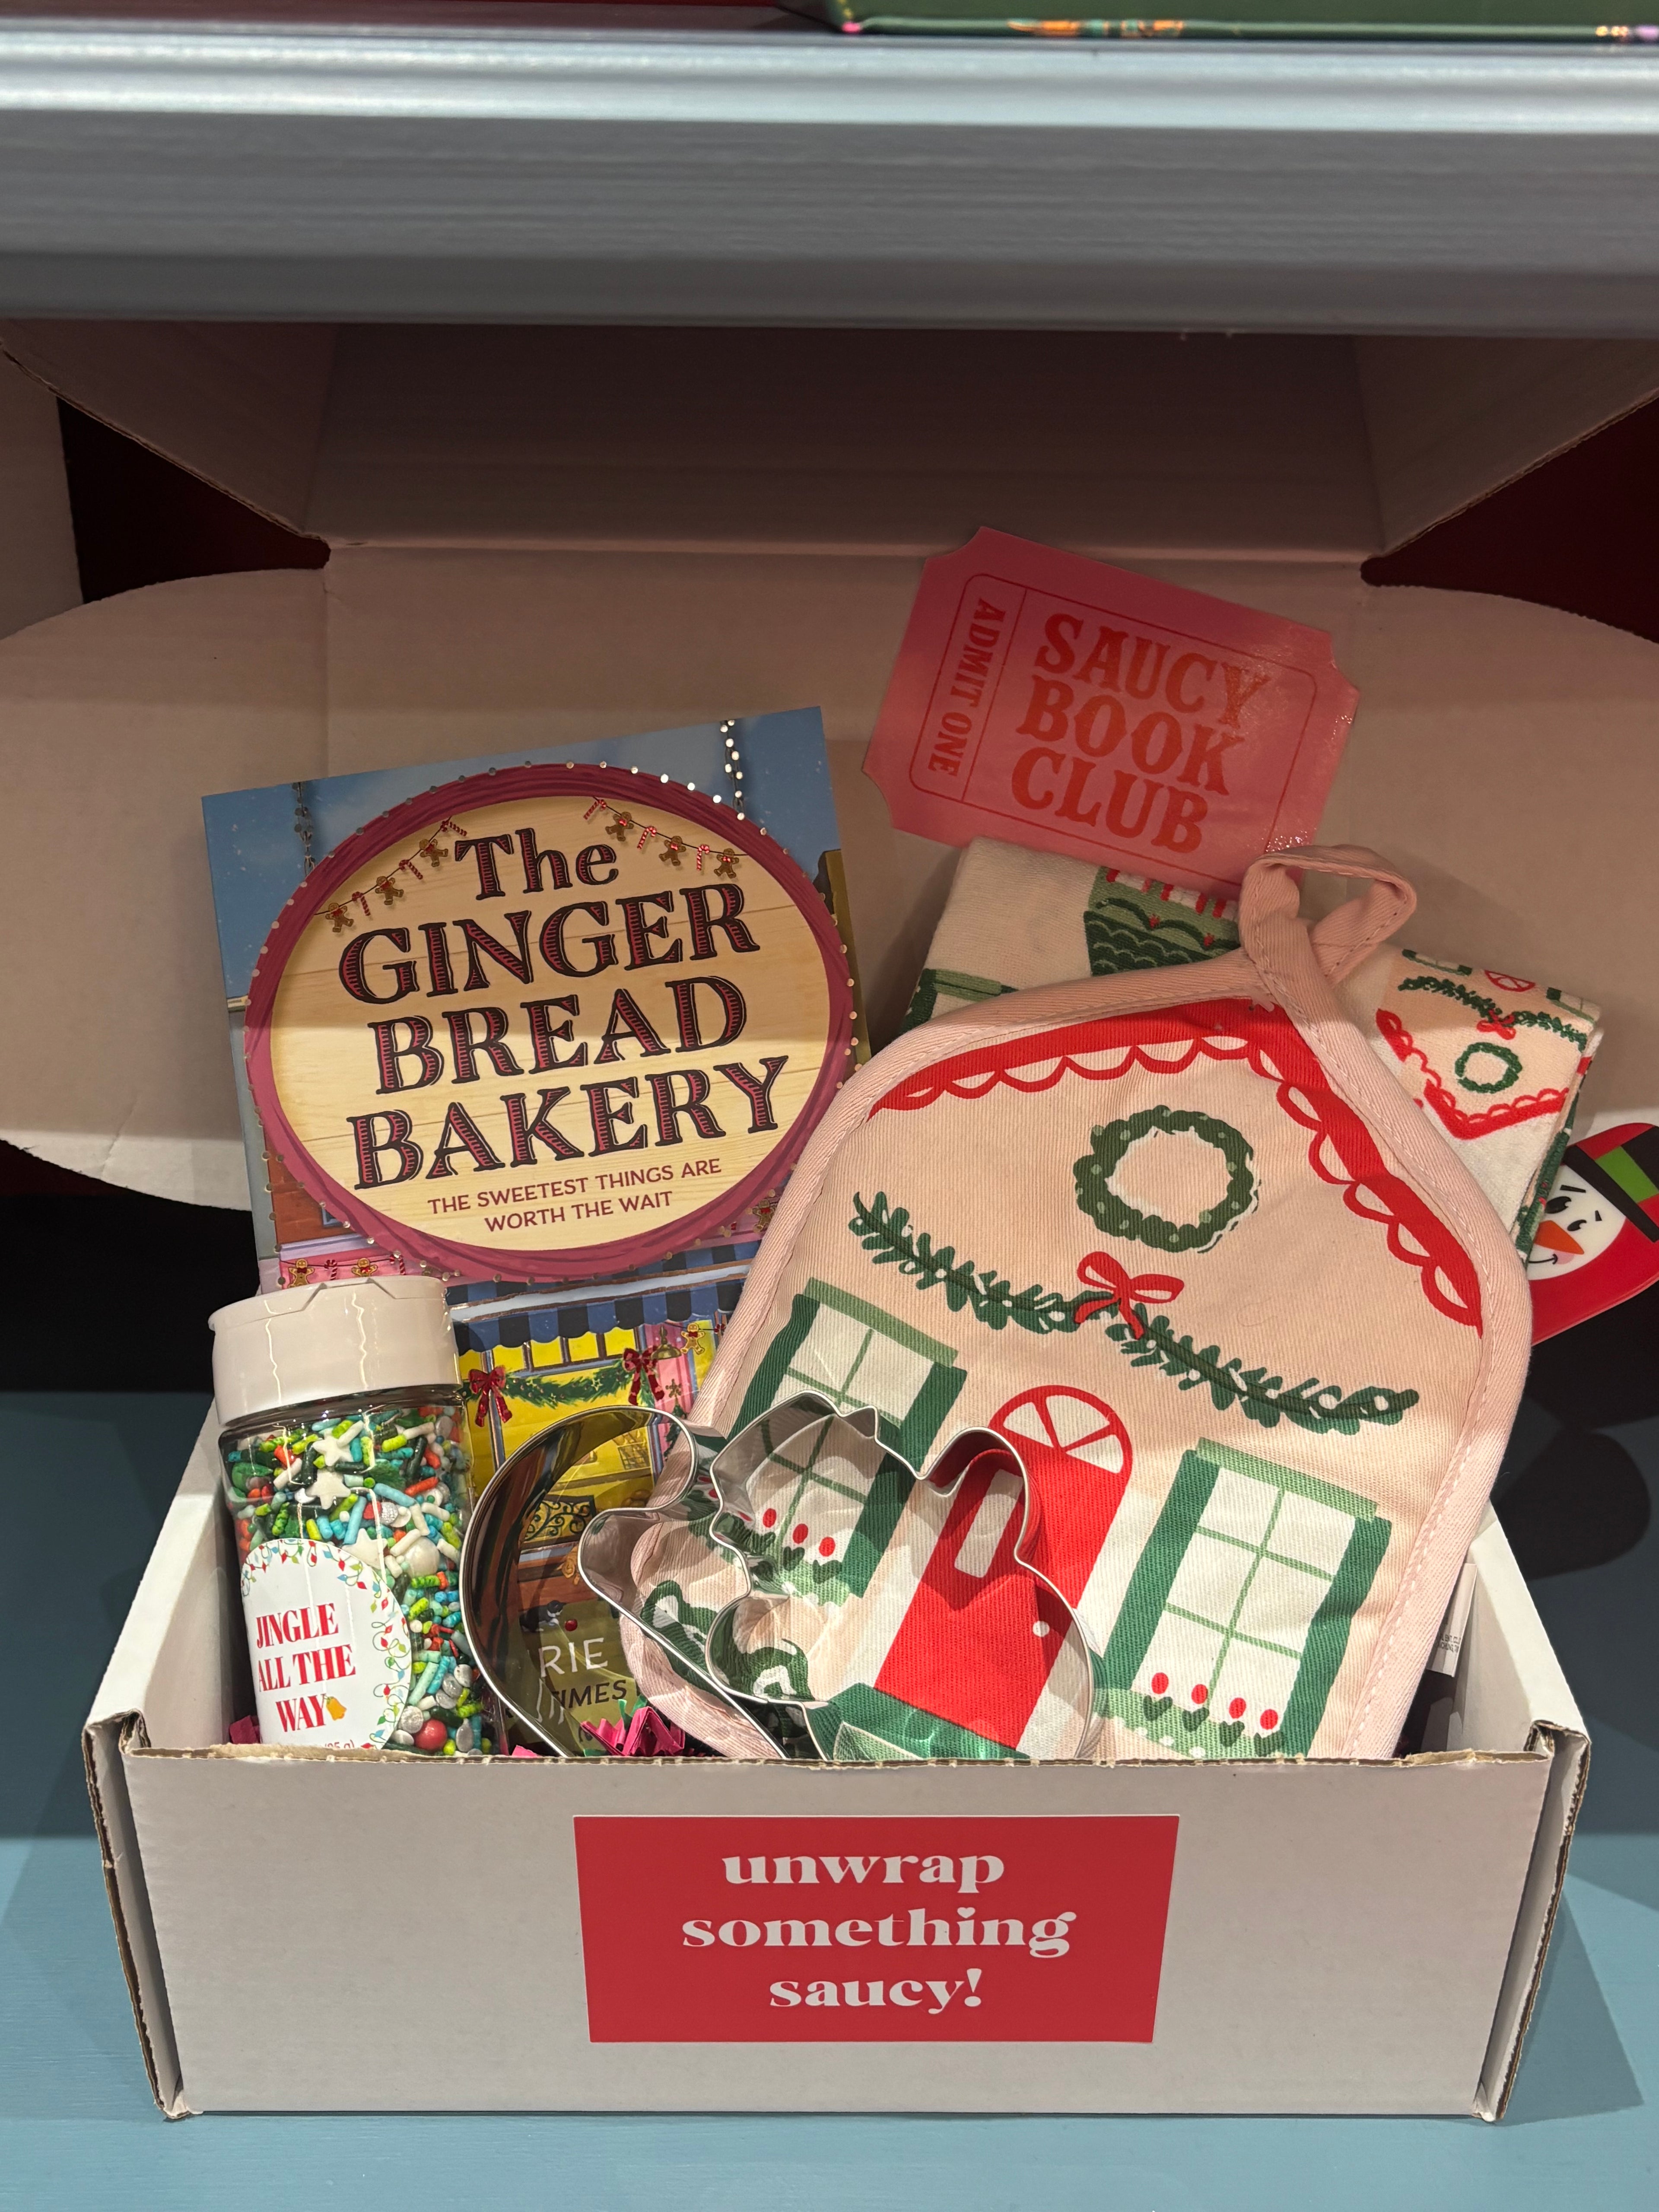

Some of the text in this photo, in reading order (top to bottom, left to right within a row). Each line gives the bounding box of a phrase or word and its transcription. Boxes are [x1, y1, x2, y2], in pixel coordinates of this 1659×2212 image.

[928, 598, 1006, 777] ADMIT ONE
[1034, 612, 1273, 730] SAUCY
[1016, 674, 1245, 796] BOOK
[1011, 747, 1208, 854] CLUB
[454, 827, 618, 900] The
[338, 884, 760, 1004] GINGER
[368, 976, 747, 1095] BREAD
[346, 1056, 788, 1189] BAKERY
[428, 1158, 722, 1214] THE SWEETEST THINGS ARE
[484, 1191, 673, 1232] WORTH THE WAIT
[256, 1603, 339, 1649] JINGLE
[292, 1644, 356, 1685] THE
[538, 1637, 608, 1678] RIE
[275, 1693, 327, 1732] WAY
[722, 1854, 1004, 1894] unwrap
[682, 1907, 1077, 1958] something
[769, 1968, 982, 2014] saucy!
